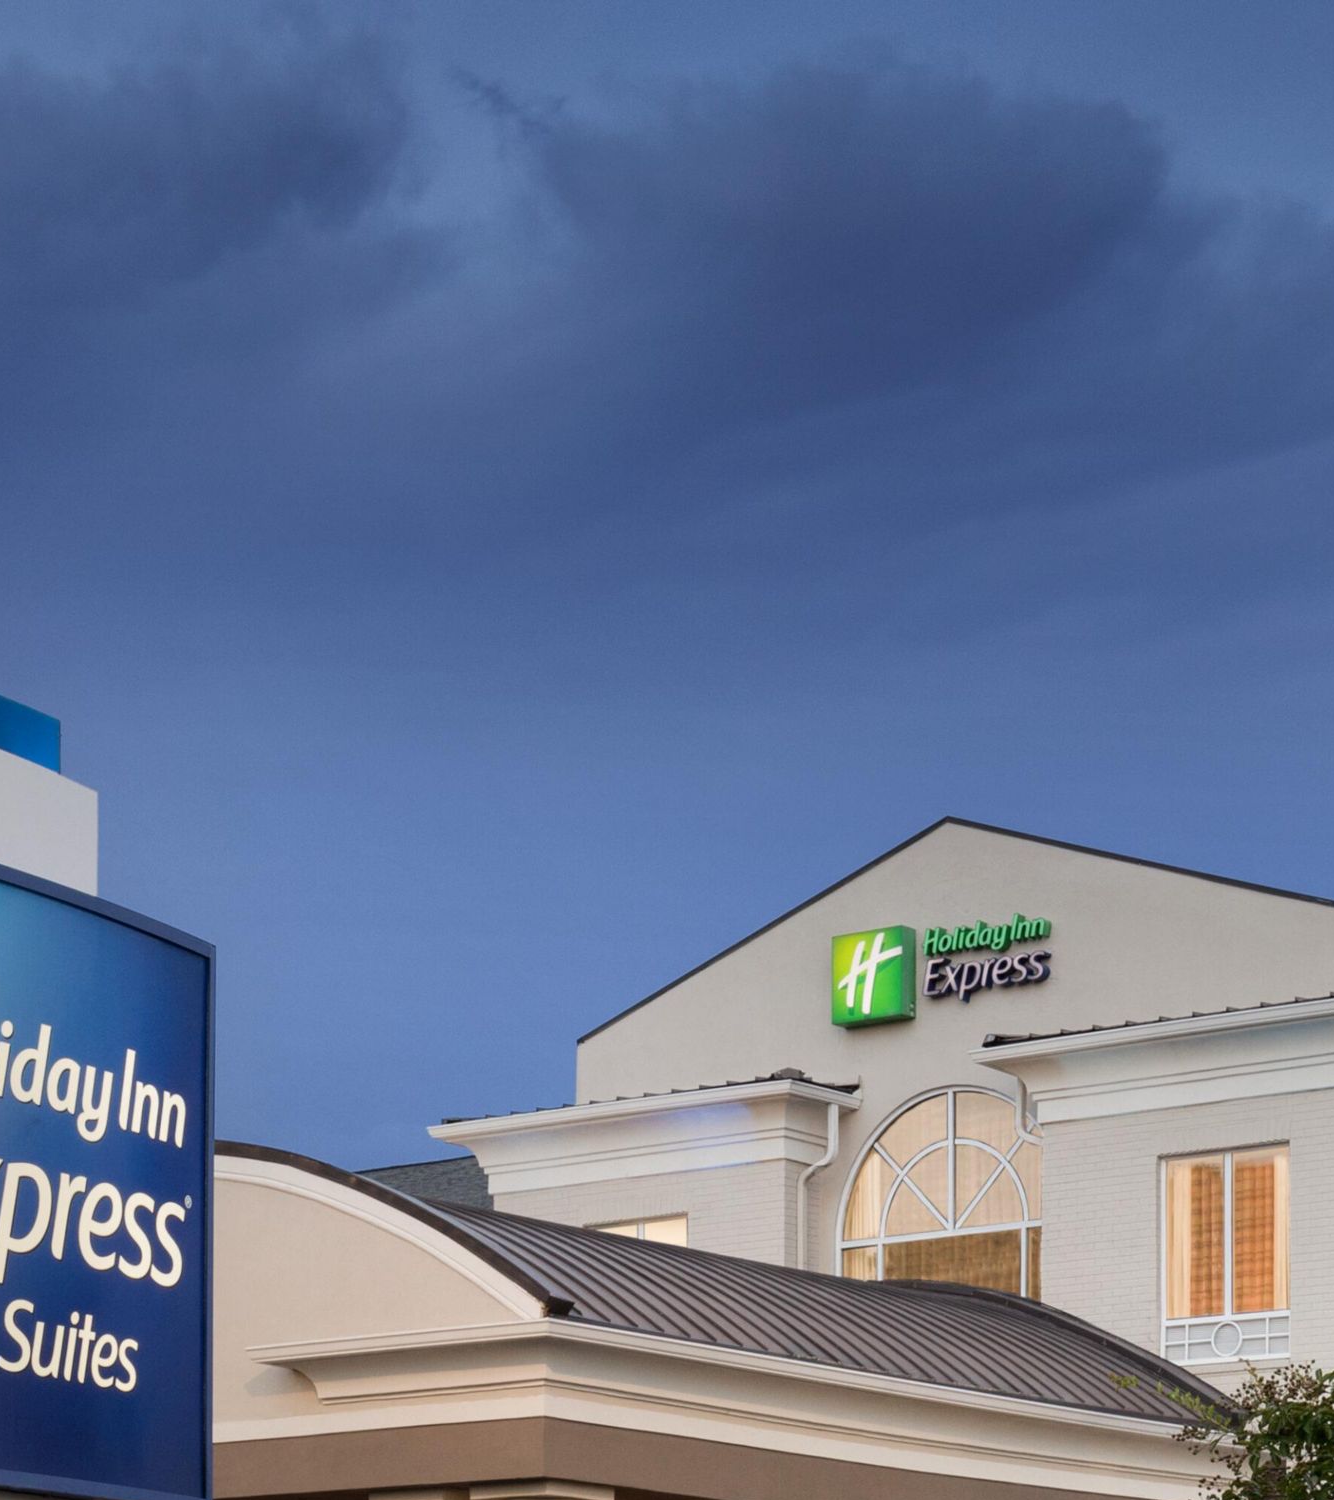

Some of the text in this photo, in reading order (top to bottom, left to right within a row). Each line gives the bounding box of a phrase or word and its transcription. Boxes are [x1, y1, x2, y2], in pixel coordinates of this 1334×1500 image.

[923, 913, 1051, 956] Holiday Inn
[923, 951, 1051, 1003] Express
[118, 1048, 186, 1148] Inn
